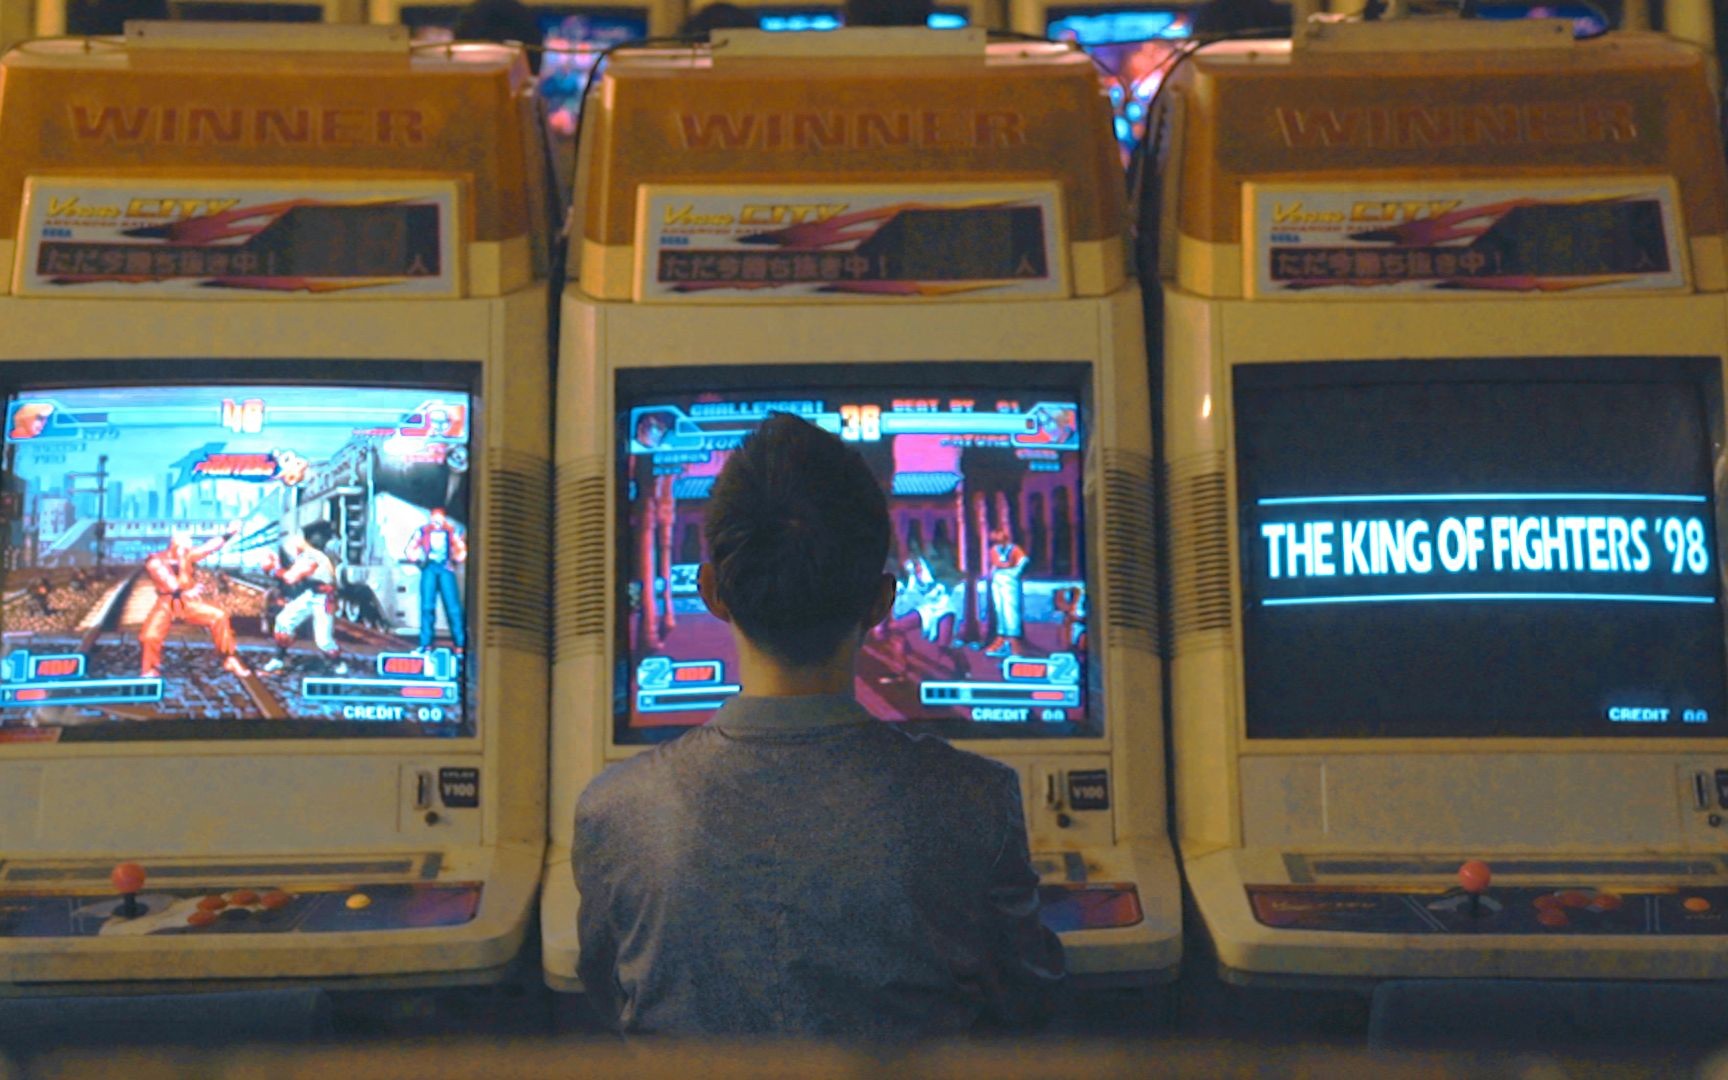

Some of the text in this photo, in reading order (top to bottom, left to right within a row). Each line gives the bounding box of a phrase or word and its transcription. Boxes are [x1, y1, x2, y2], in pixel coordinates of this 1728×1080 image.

[71, 104, 427, 146] WINNER
[678, 110, 1028, 149] WINNER
[1275, 104, 1638, 148] WINNER
[1261, 520, 1336, 579] THE
[1341, 518, 1432, 576] KING
[1437, 516, 1485, 574] OF
[1490, 515, 1652, 574] FIGHTERS
[343, 705, 443, 721] CREDIT 00
[971, 708, 1029, 721] CREDIT
[1608, 707, 1670, 721] CREDIT
